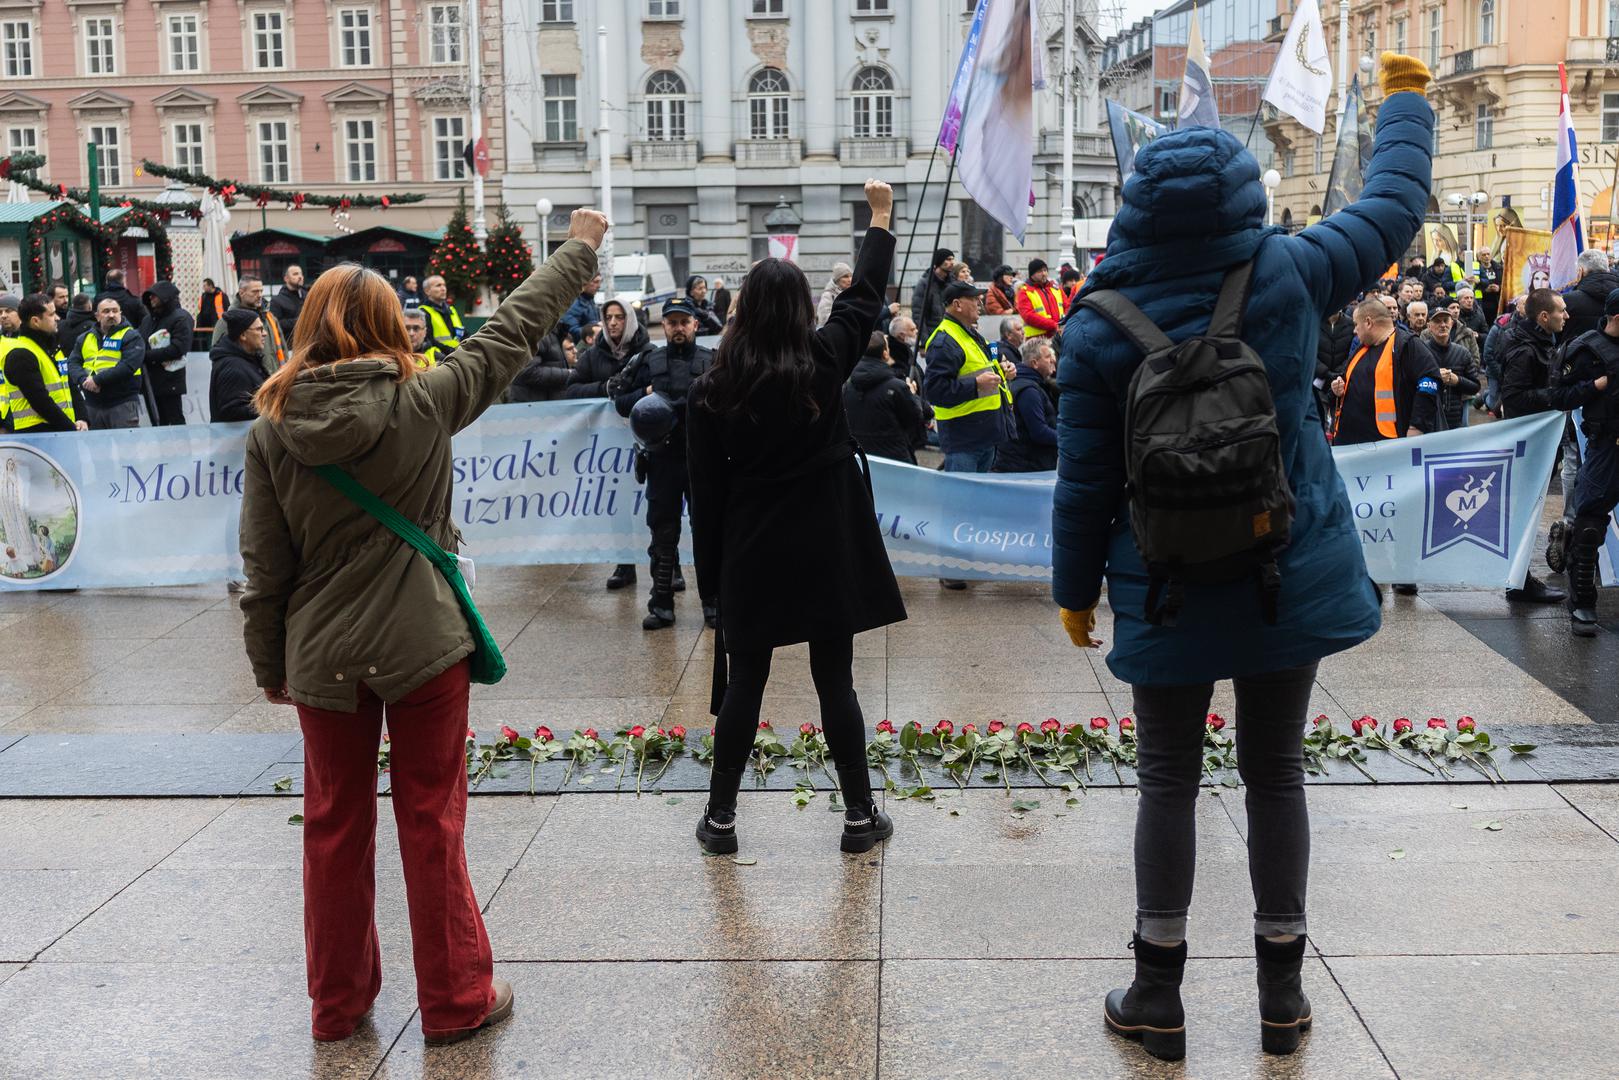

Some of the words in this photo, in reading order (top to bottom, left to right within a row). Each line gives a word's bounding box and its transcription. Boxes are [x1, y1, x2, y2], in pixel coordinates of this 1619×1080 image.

[452, 440, 560, 484] svaki
[464, 476, 618, 524] izmolili
[1457, 495, 1478, 512] M
[953, 522, 1036, 551] Gospa
